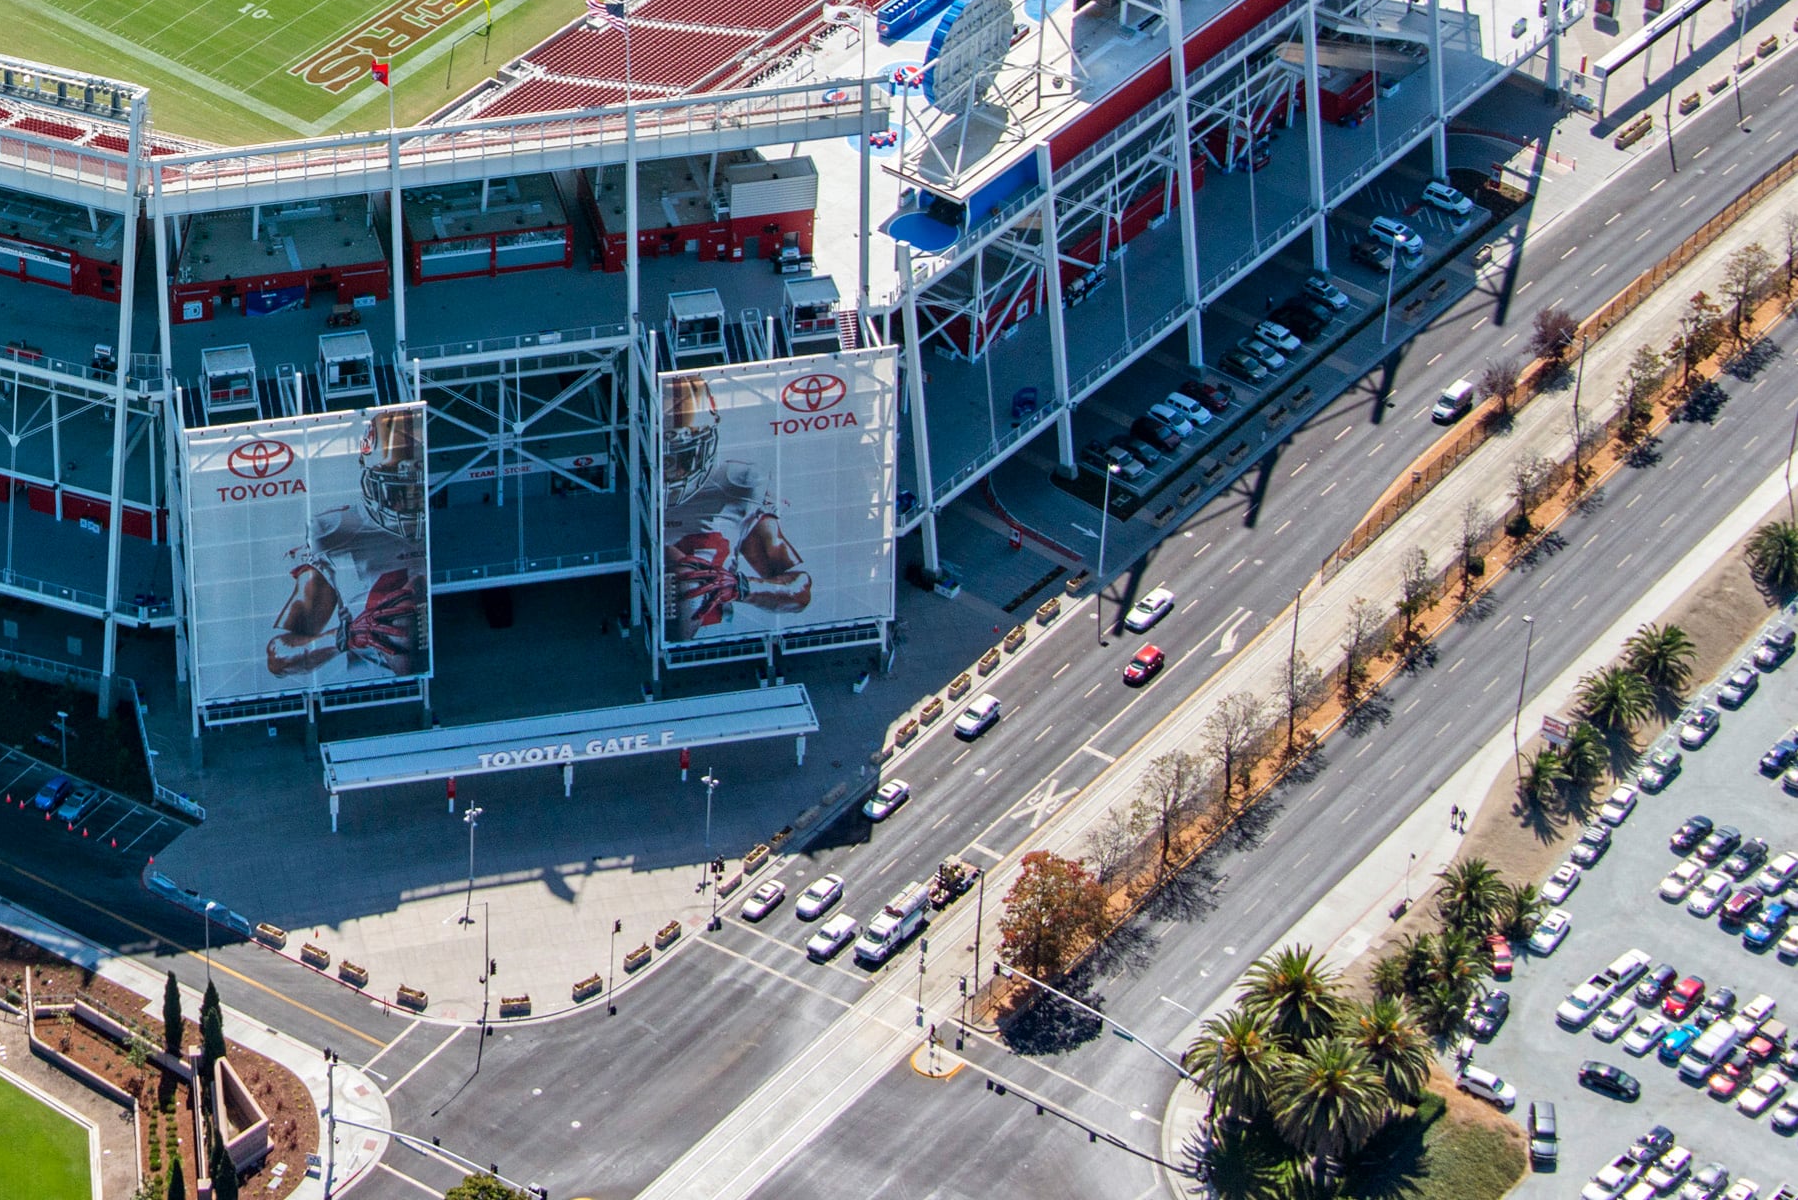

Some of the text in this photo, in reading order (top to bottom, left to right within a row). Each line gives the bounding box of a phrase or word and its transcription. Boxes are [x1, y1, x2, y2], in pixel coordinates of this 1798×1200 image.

[237, 3, 269, 19] 10
[770, 412, 858, 435] TOYOTA
[469, 464, 531, 479] TEAM STORE
[216, 479, 307, 502] TOYOTA
[478, 729, 675, 769] TOYOTA GATE F
